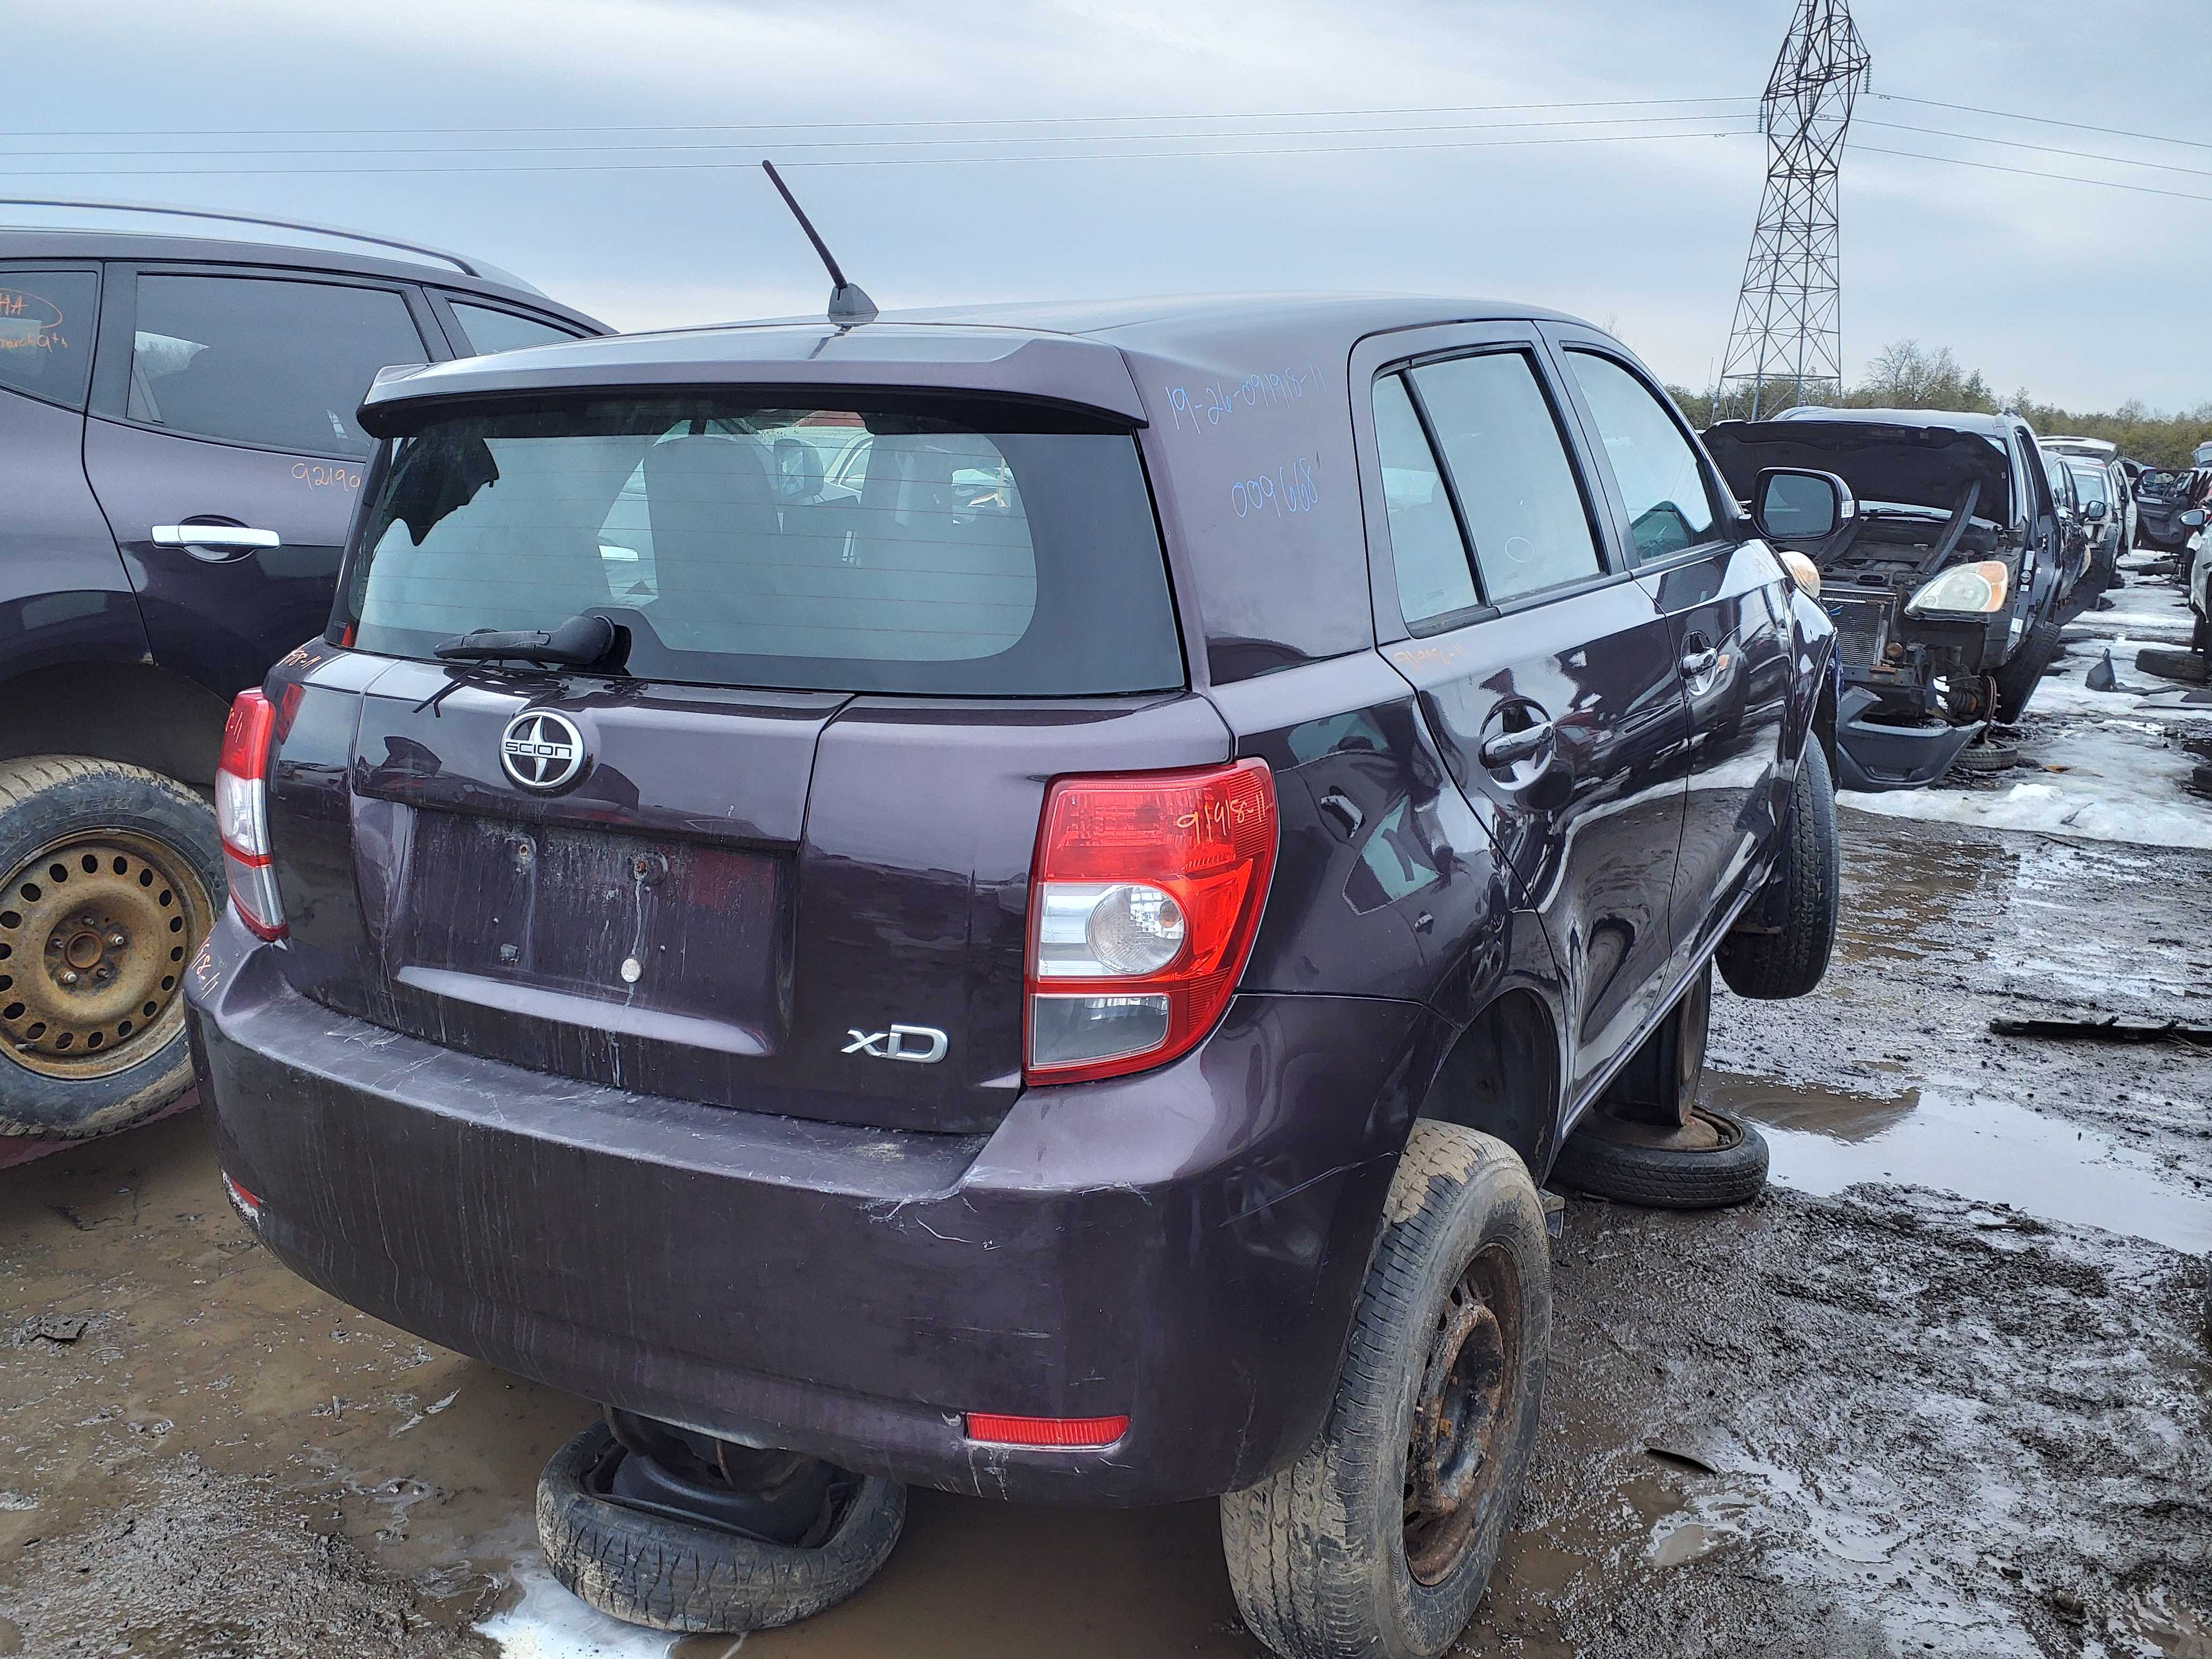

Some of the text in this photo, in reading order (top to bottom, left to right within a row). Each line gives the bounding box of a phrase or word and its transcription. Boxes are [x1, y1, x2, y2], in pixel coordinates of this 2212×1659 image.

[1231, 457, 1319, 518] 009668
[504, 741, 572, 758] SCION
[1176, 790, 1266, 845] 91918-11
